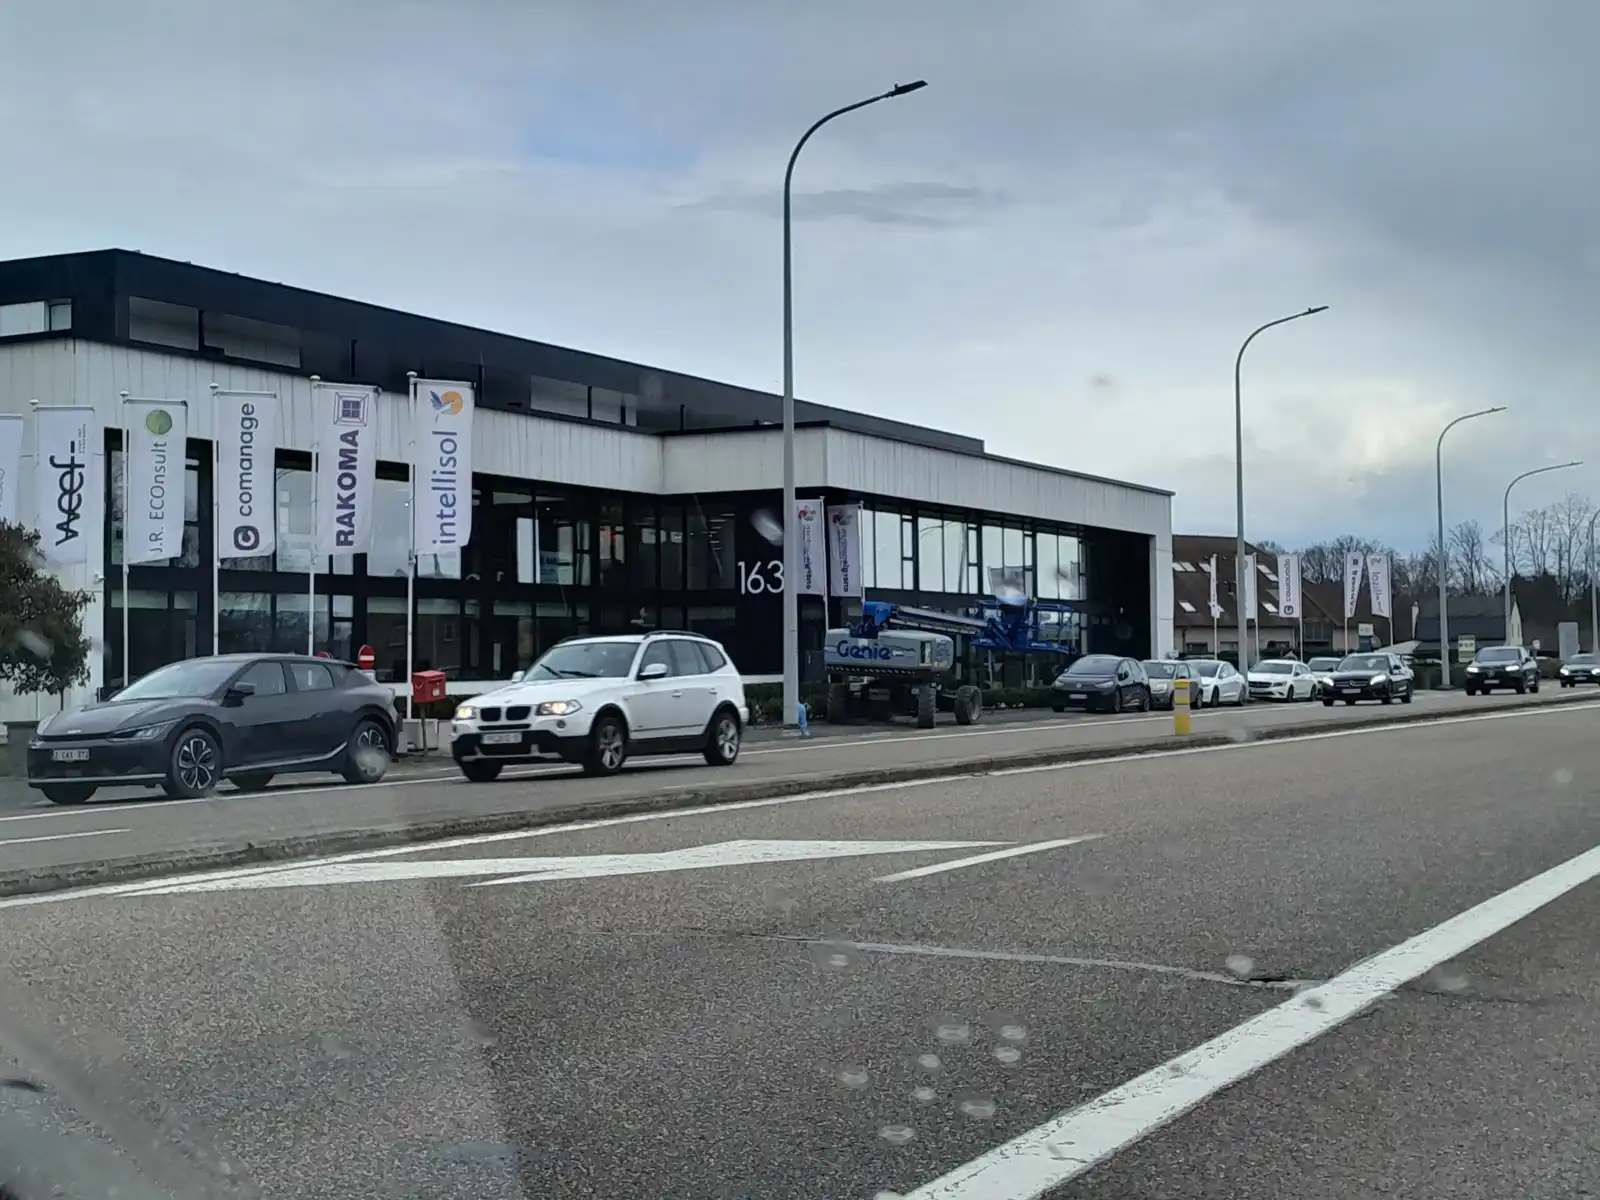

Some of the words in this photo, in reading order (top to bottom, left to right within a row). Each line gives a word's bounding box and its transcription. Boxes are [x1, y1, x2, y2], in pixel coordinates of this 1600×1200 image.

[149, 441, 168, 520] ECOnsult
[239, 403, 259, 517] comanage
[335, 430, 359, 547] RAKOMA
[431, 431, 458, 544] intellisol
[148, 526, 164, 553] J.R.
[737, 560, 785, 595] 163
[836, 639, 891, 661] Genie
